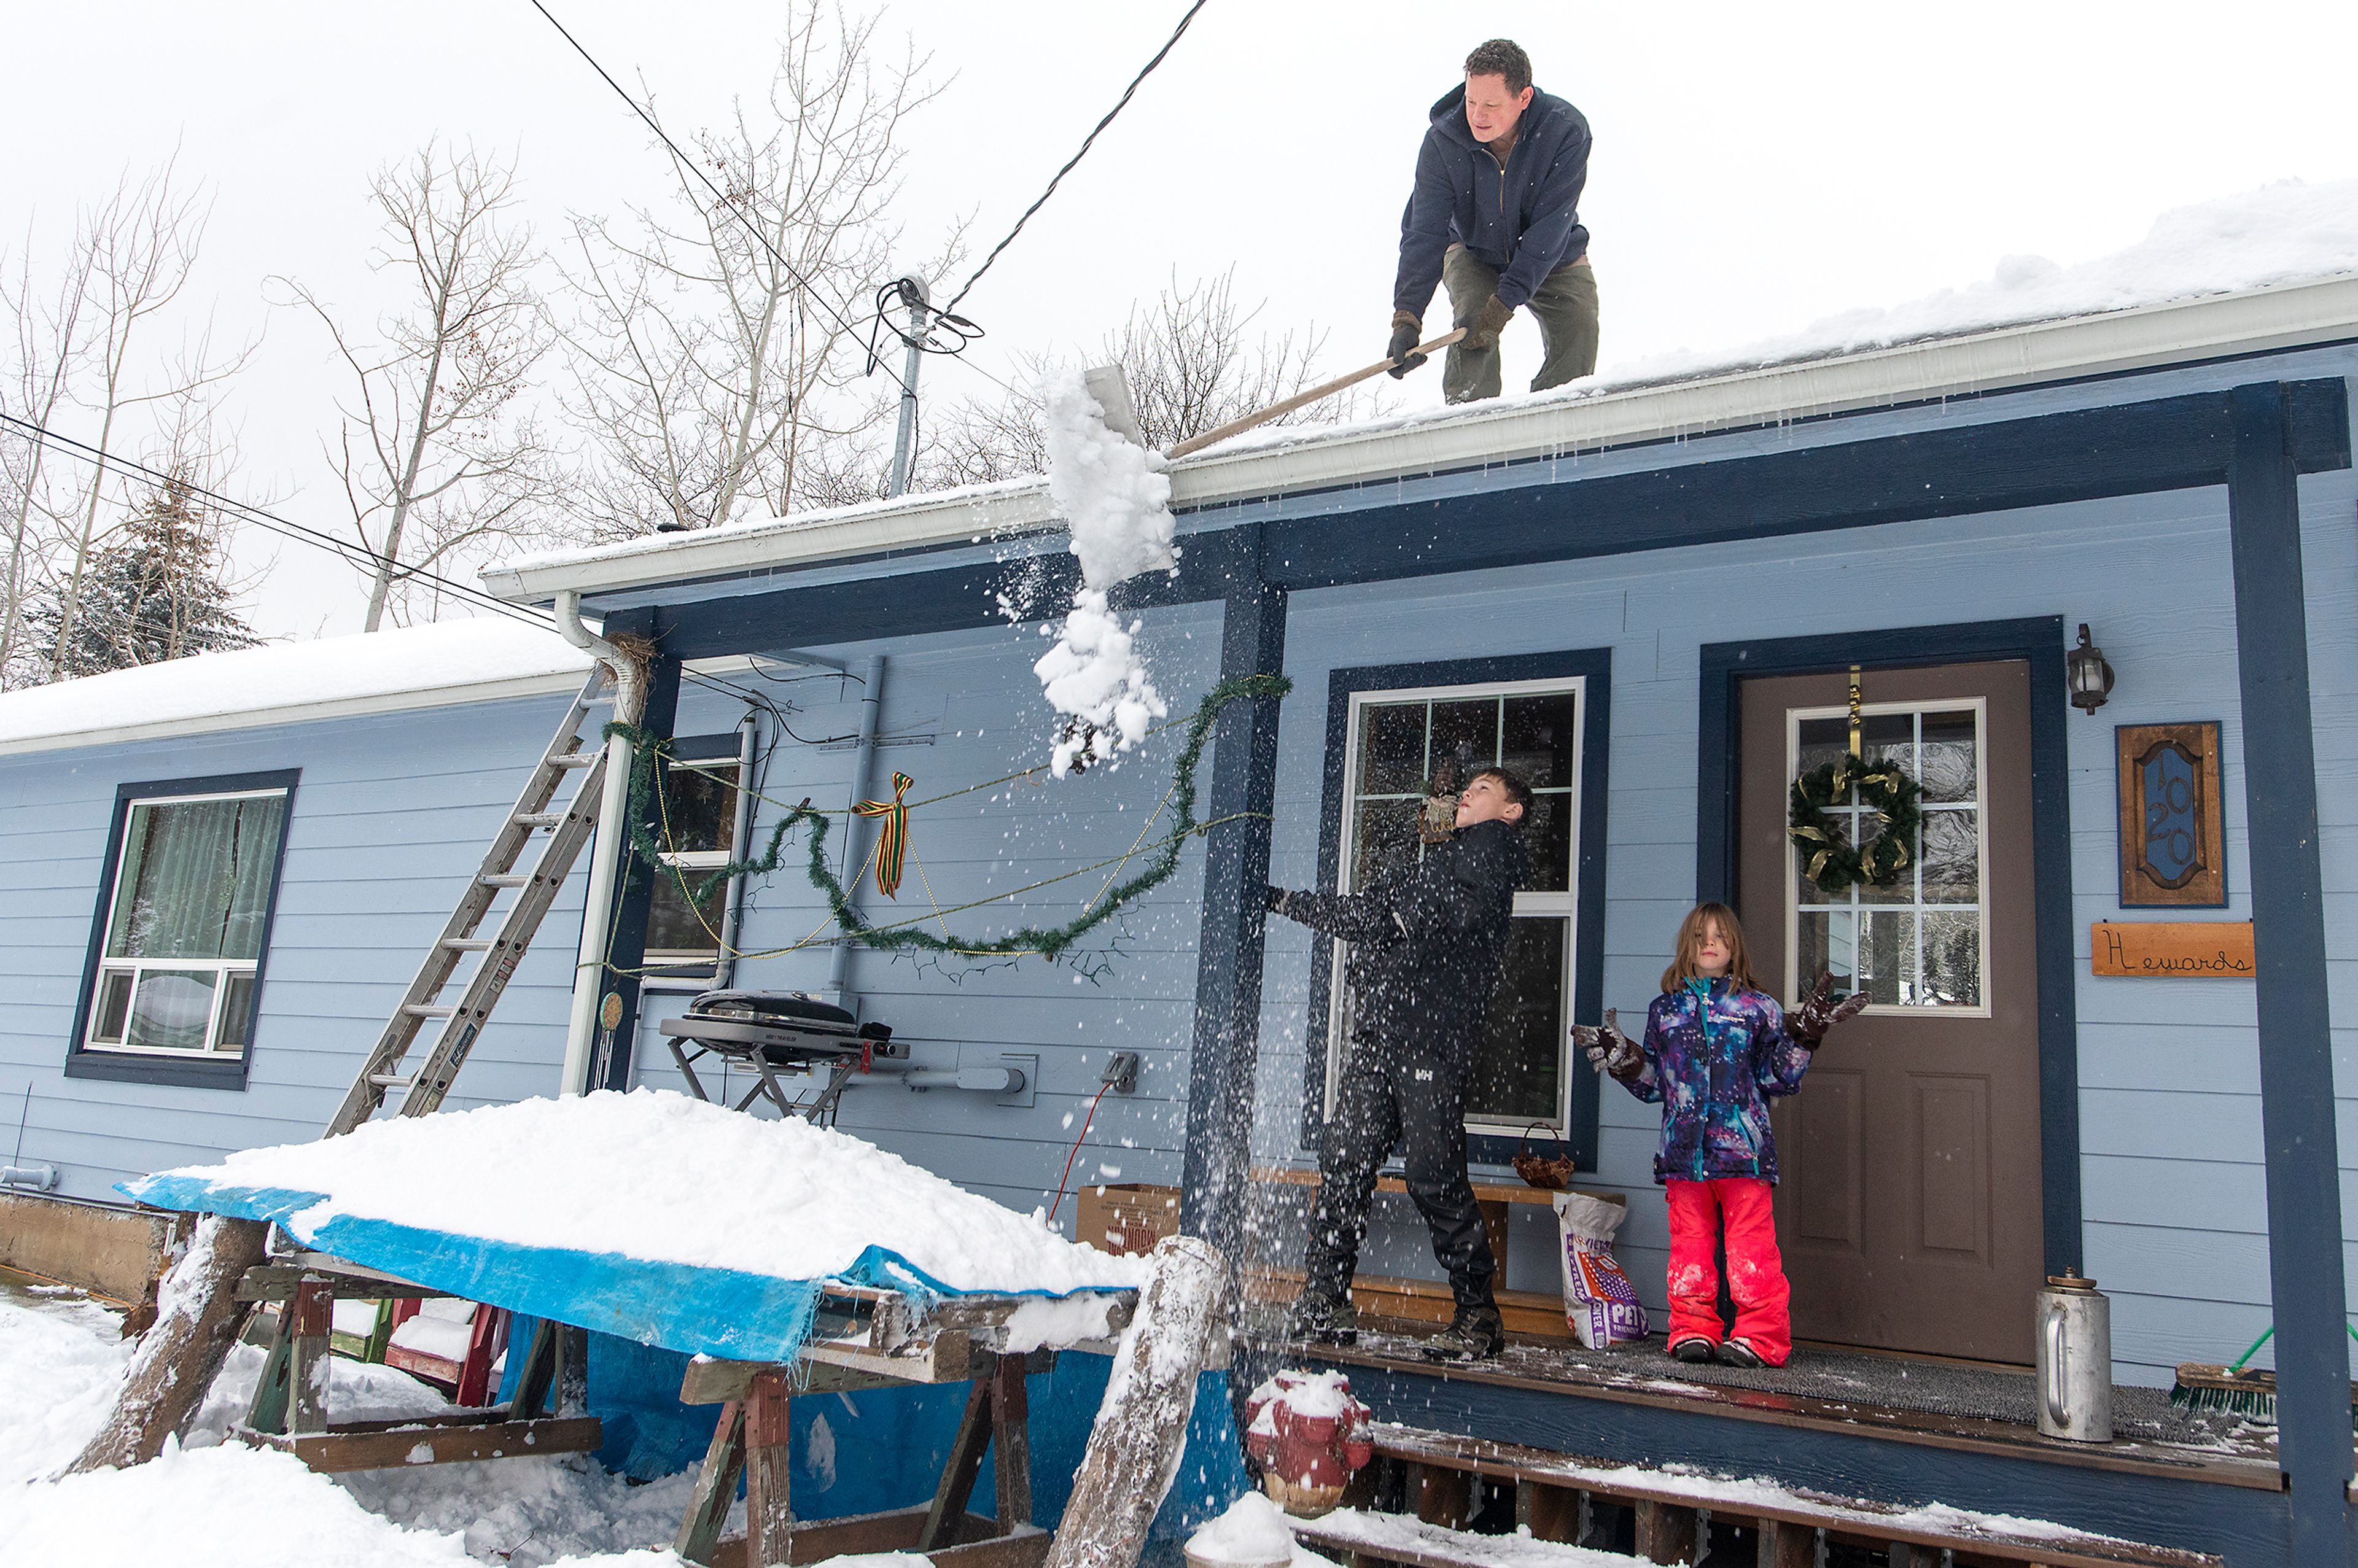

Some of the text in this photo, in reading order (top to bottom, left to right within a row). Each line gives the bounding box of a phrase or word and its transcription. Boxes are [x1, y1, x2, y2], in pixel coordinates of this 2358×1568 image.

[1415, 1068, 1433, 1081] HH
[1612, 1303, 1639, 1327] PET
[1614, 1324, 1640, 1335] FRIENDLY
